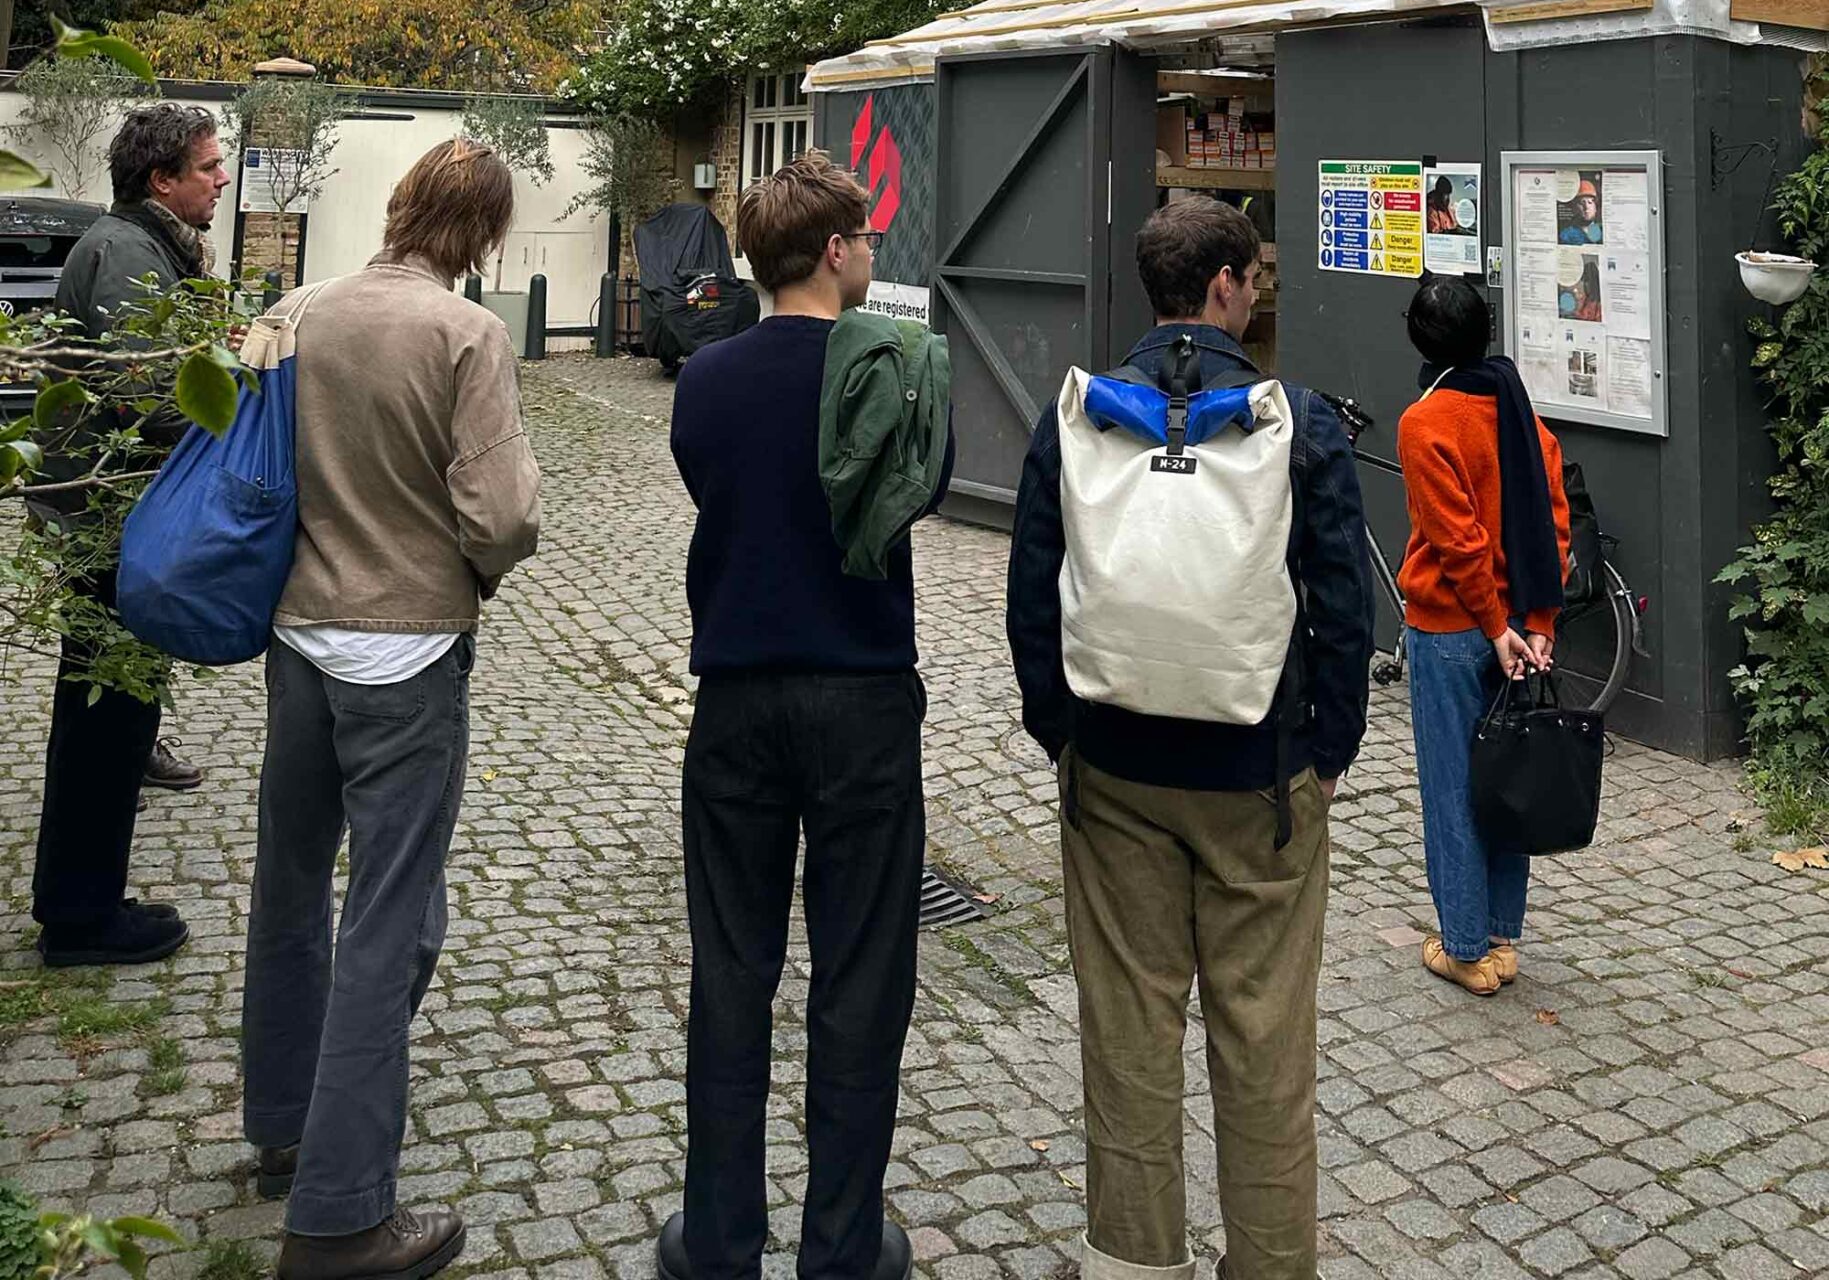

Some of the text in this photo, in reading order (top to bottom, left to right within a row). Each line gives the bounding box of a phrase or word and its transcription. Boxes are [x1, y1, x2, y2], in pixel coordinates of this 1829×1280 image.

[1345, 165, 1391, 174] SITE SAFETY
[1391, 235, 1413, 245] Danger
[1391, 255, 1413, 265] Danger
[868, 299, 882, 312] are
[883, 300, 926, 320] registered
